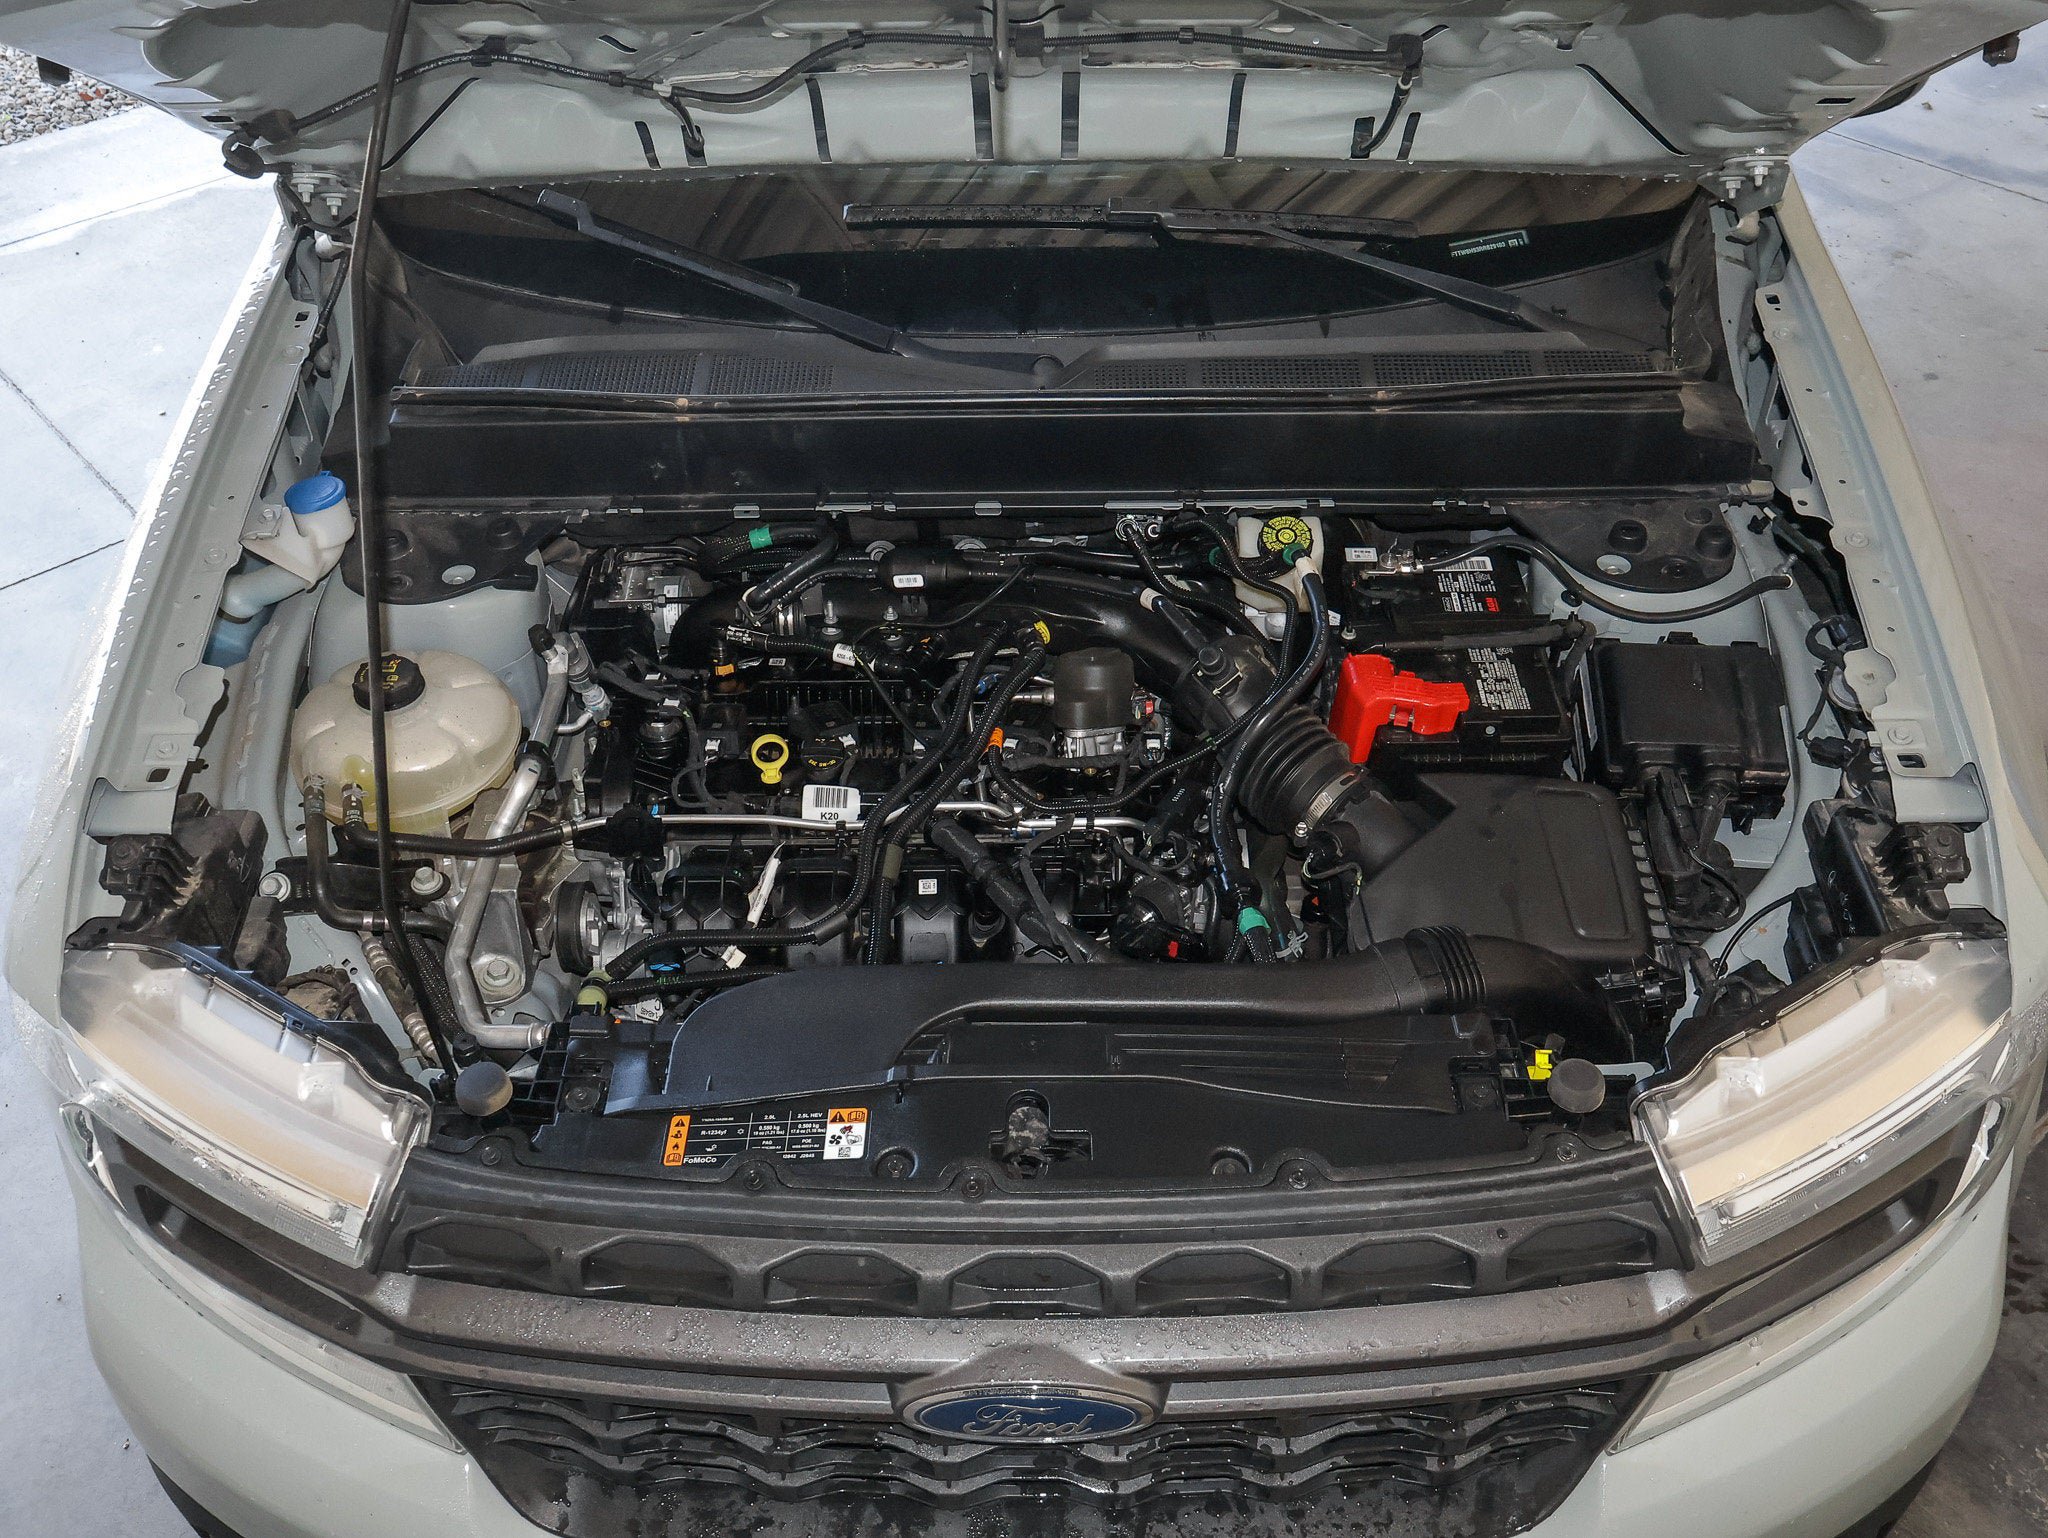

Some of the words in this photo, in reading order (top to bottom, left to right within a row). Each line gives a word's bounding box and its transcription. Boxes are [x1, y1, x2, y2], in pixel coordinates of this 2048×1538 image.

[820, 812, 839, 821] K20
[683, 1156, 717, 1164] FoMoCo
[962, 1403, 1095, 1438] Ford
